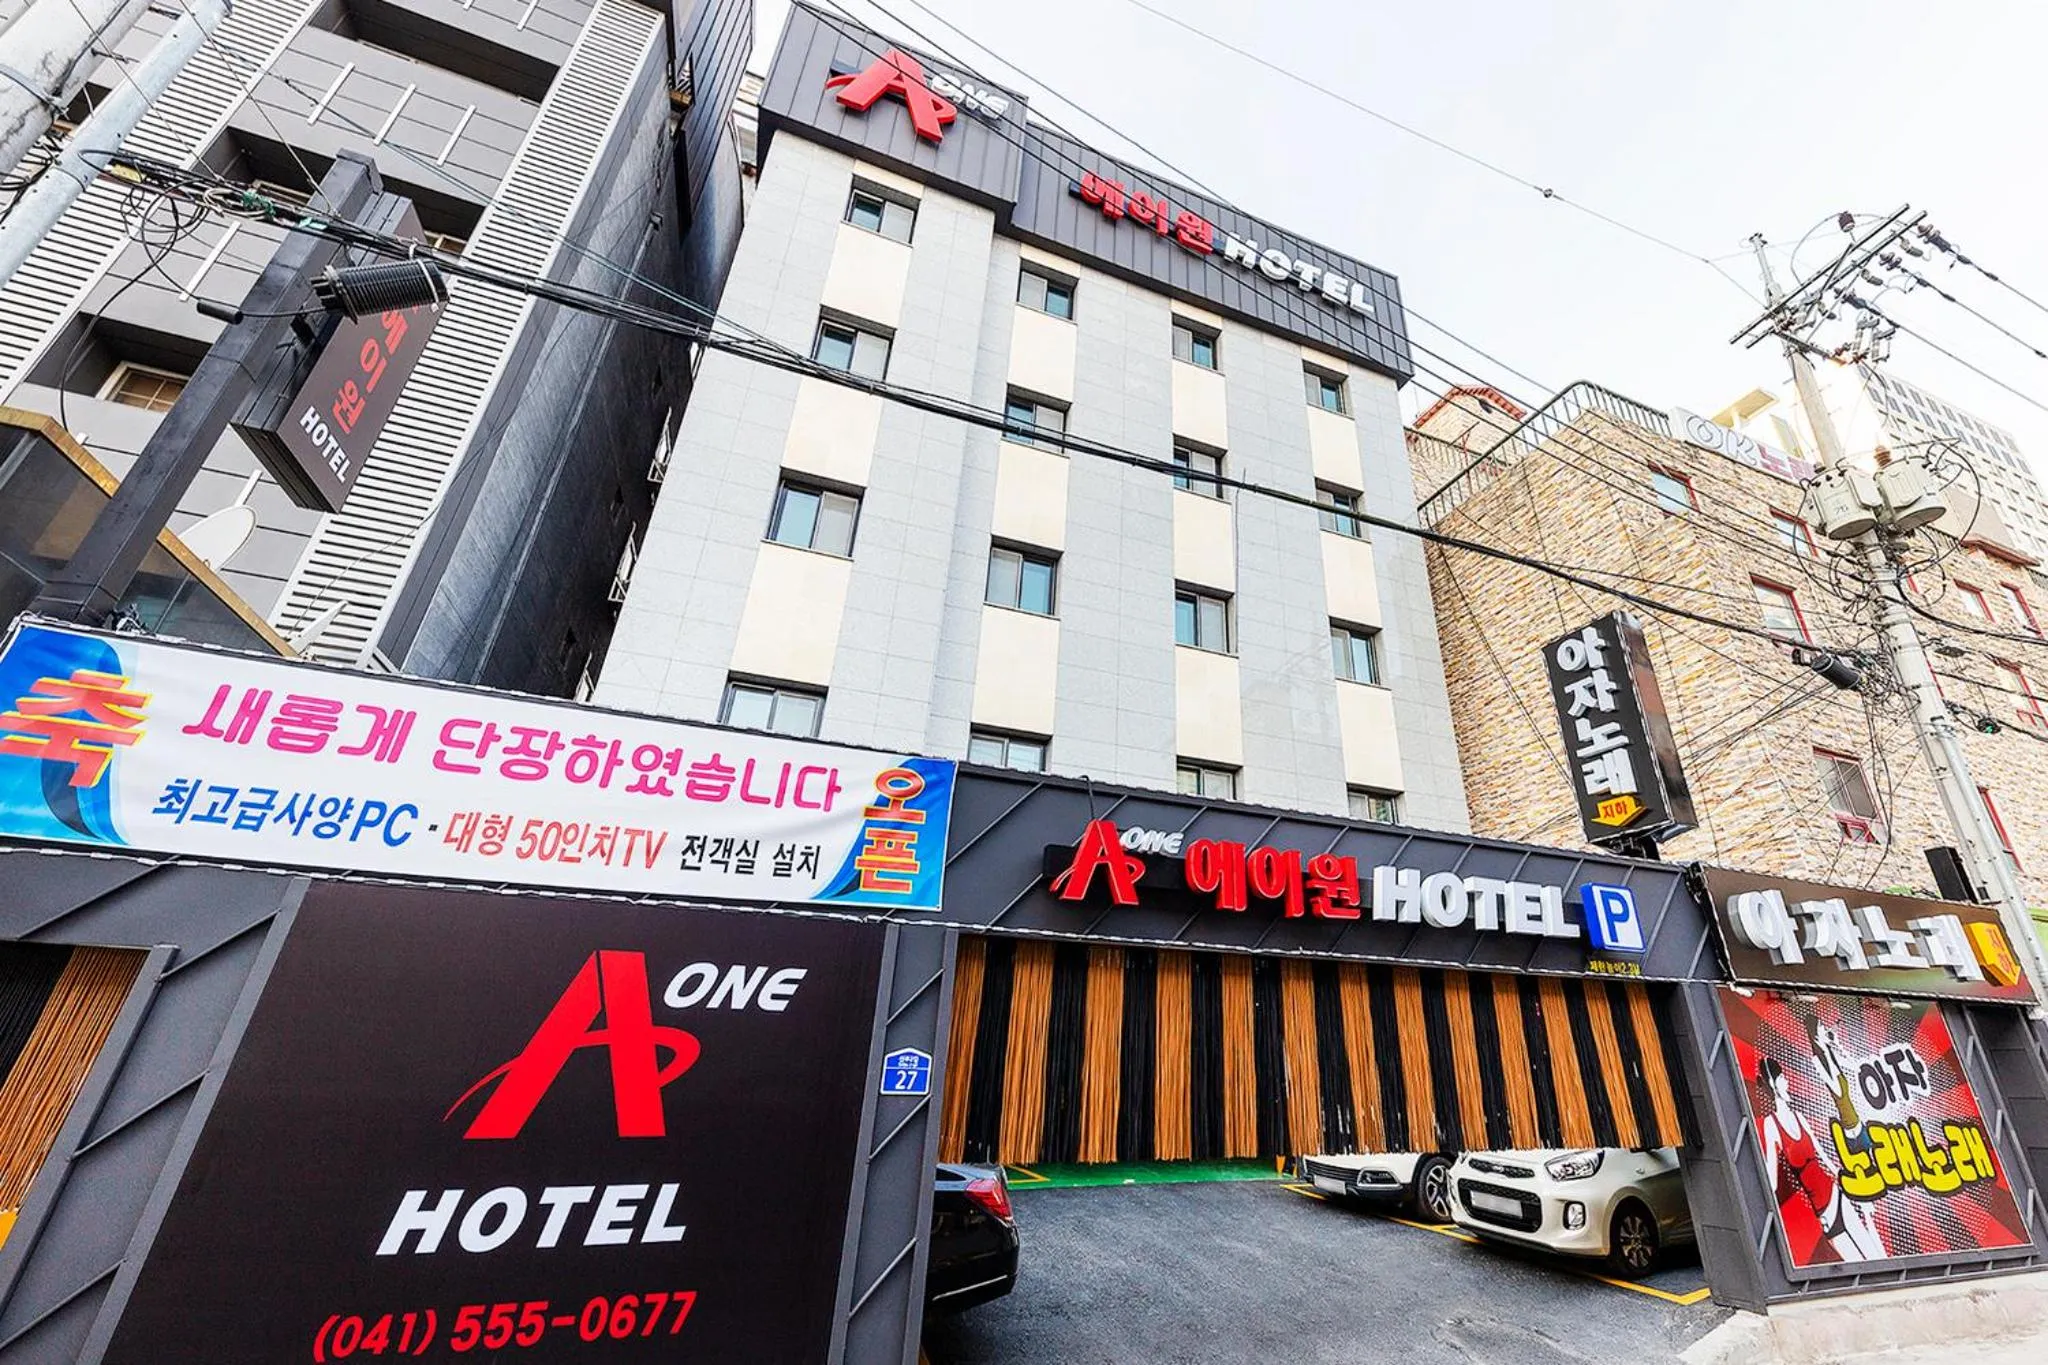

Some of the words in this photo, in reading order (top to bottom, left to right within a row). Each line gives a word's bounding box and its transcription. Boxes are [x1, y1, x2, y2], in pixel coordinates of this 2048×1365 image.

[1080, 169, 1214, 256] 에이원
[1223, 231, 1376, 314] HOTEL
[300, 406, 351, 483] HOTEL
[0, 668, 153, 788] 축
[182, 684, 418, 763] 새롭게
[432, 718, 842, 813] 단장하였습니다
[152, 778, 419, 847] 최고급사양PC
[443, 812, 514, 856] 대형
[515, 819, 669, 870] 50인치TV
[680, 834, 760, 875] 전객실
[772, 842, 821, 880] 설치
[855, 766, 927, 893] 오픈
[1120, 826, 1185, 855] ONE
[1601, 800, 1628, 819] 지하
[1184, 838, 1361, 919] 에이원
[1373, 865, 1581, 939] HOTEL
[1599, 889, 1631, 943] P
[1727, 889, 1986, 982] 아자노래
[663, 962, 808, 1011] ONE
[895, 1069, 918, 1090] 27
[1858, 1048, 1928, 1111] 아자
[1829, 1116, 1997, 1202] 노래노래
[375, 1183, 688, 1256] HOTEL
[312, 1309, 438, 1363] (041)
[451, 1290, 698, 1353] 555-0677
